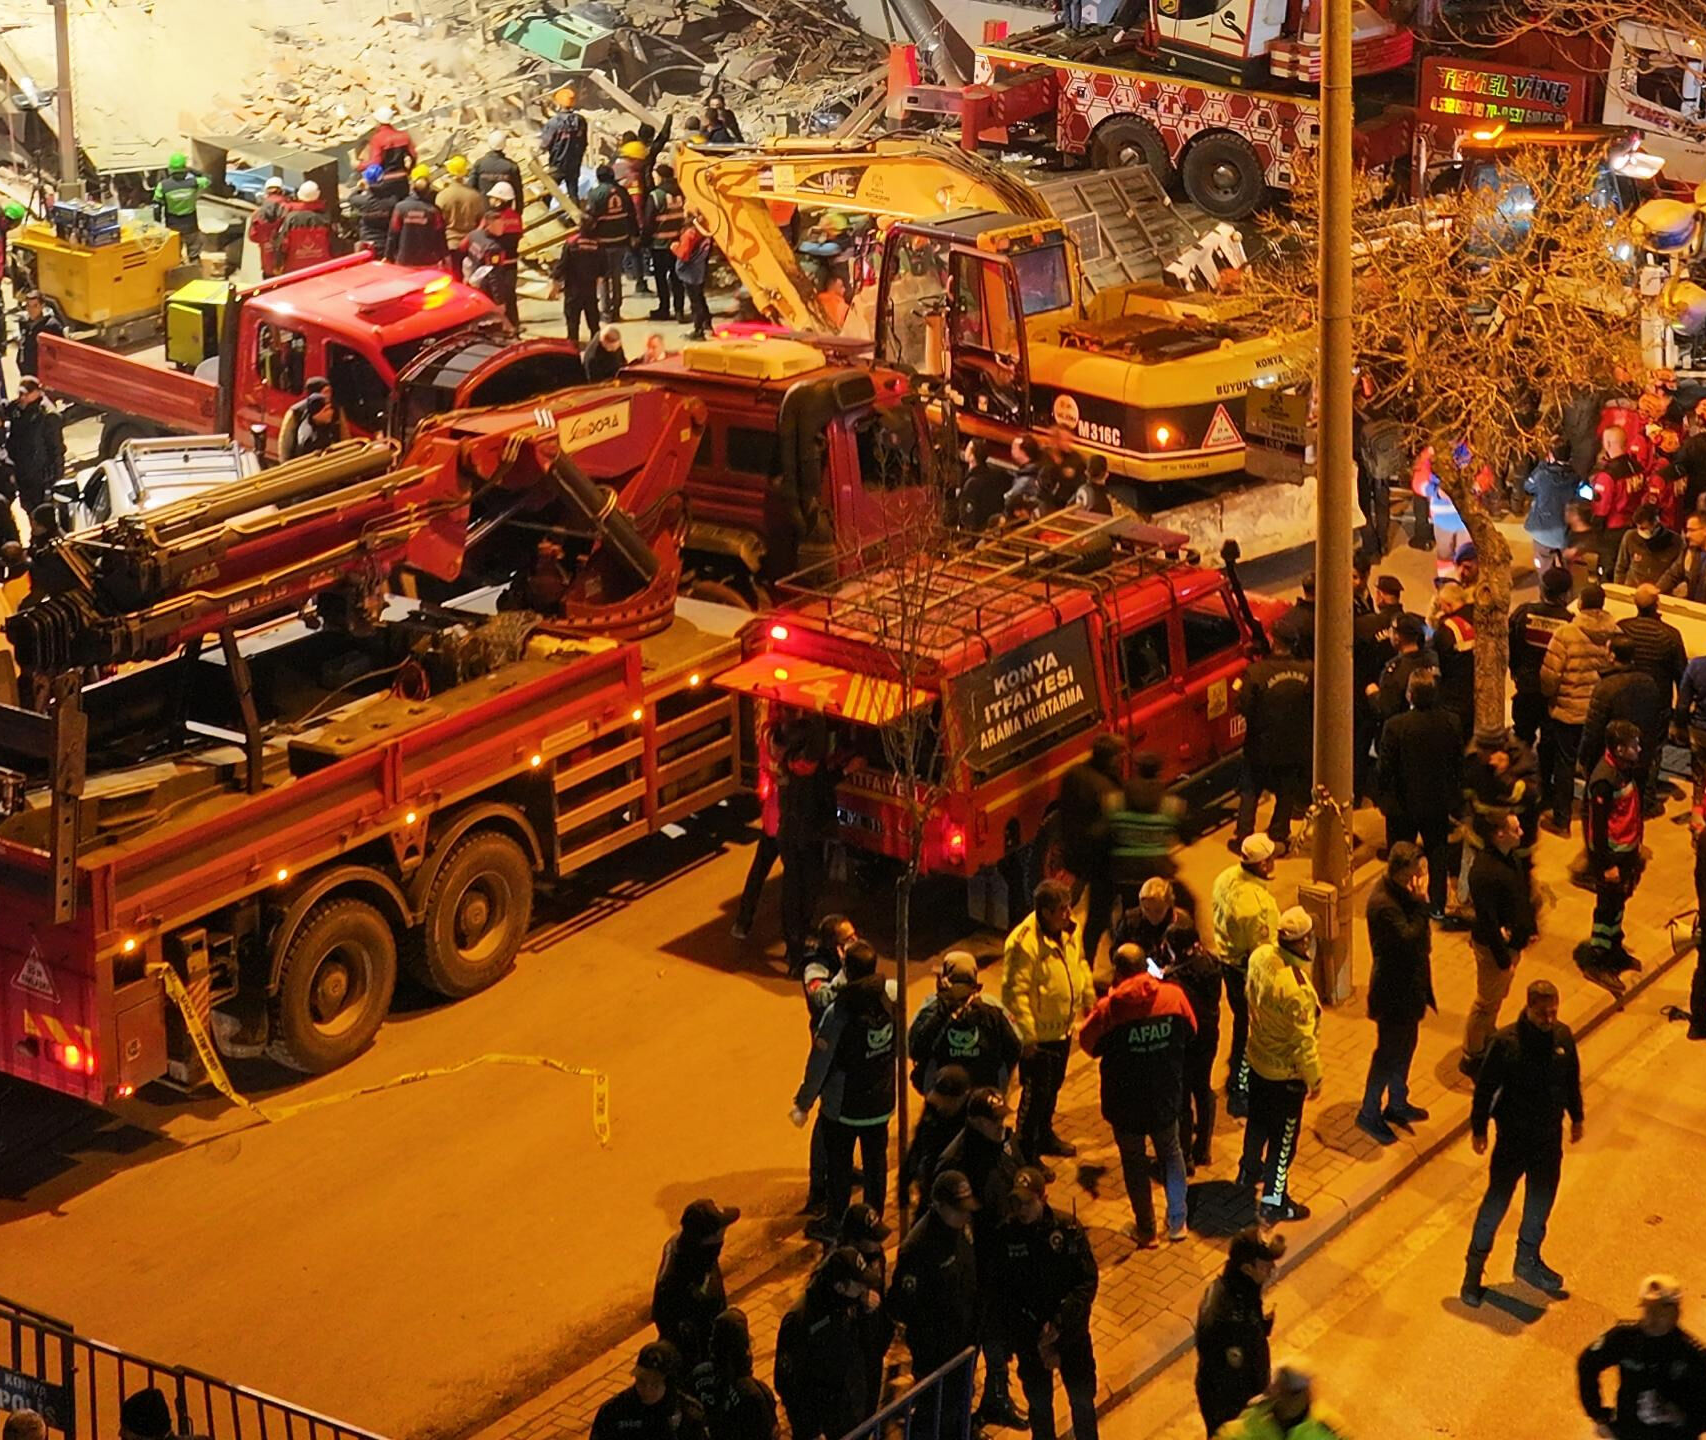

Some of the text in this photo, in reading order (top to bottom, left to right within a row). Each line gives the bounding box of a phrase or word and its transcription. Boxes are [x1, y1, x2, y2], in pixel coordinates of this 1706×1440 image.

[1436, 66, 1572, 109] TEMEL VİNÇ
[1078, 420, 1122, 446] M316C
[994, 651, 1059, 697] KONYA
[980, 684, 1085, 751] ARAMA KURTARMA
[1128, 1022, 1172, 1044] AFAD
